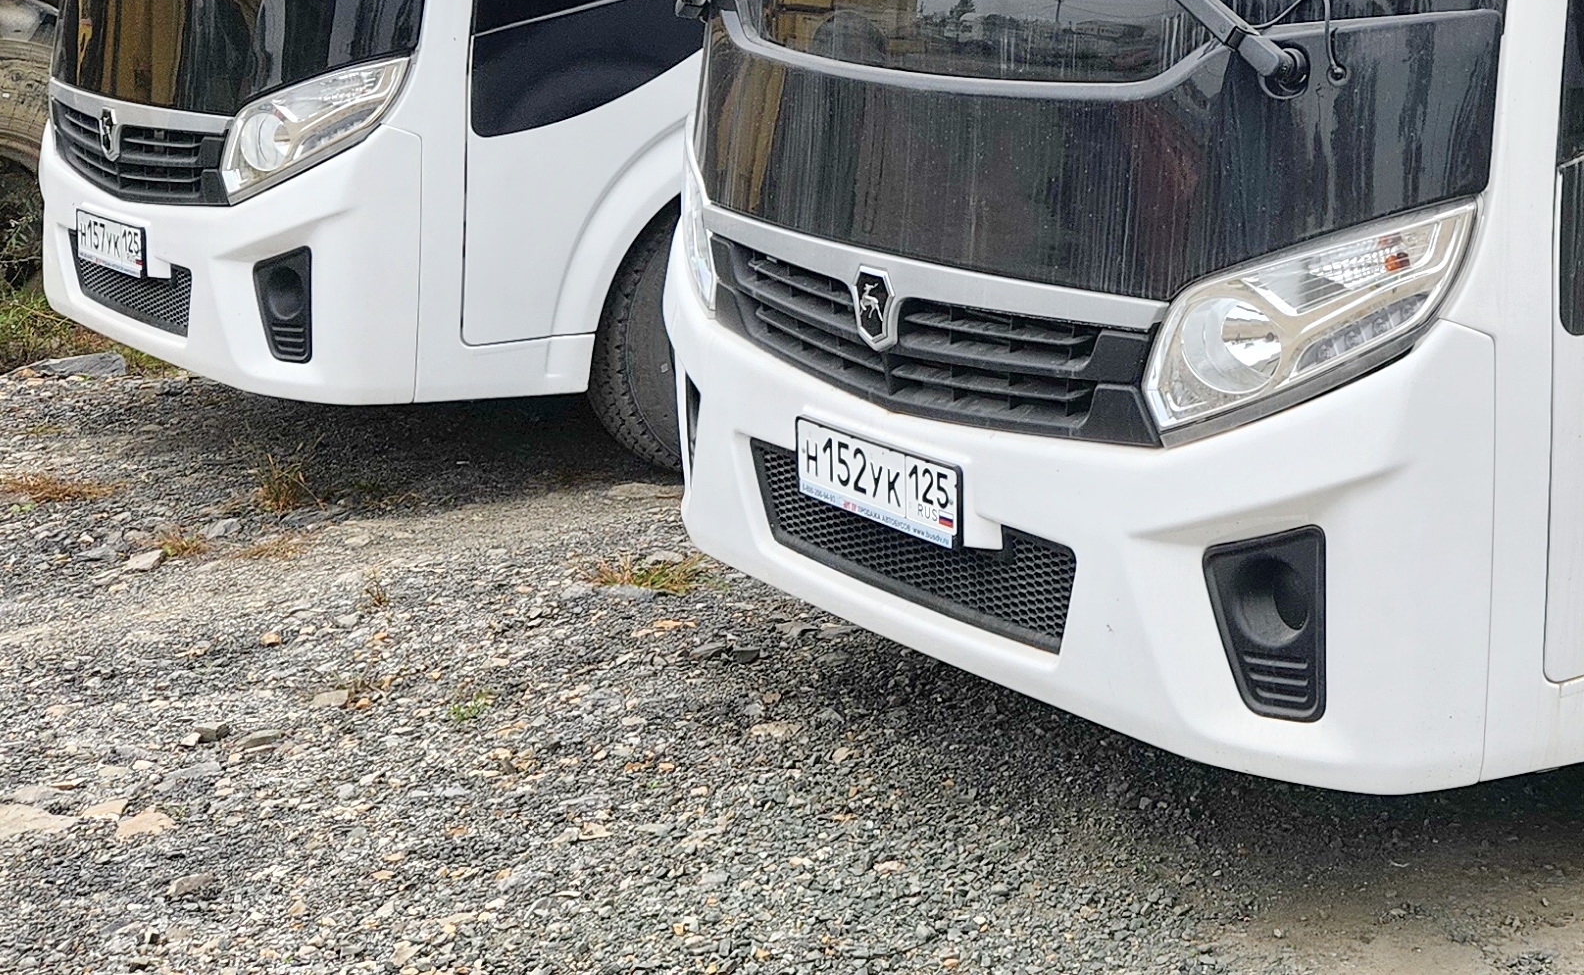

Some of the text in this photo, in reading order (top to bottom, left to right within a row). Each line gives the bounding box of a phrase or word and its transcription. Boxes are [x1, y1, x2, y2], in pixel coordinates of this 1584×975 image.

[121, 229, 141, 255] 125
[909, 464, 949, 509] 125
[917, 503, 938, 522] RUS
